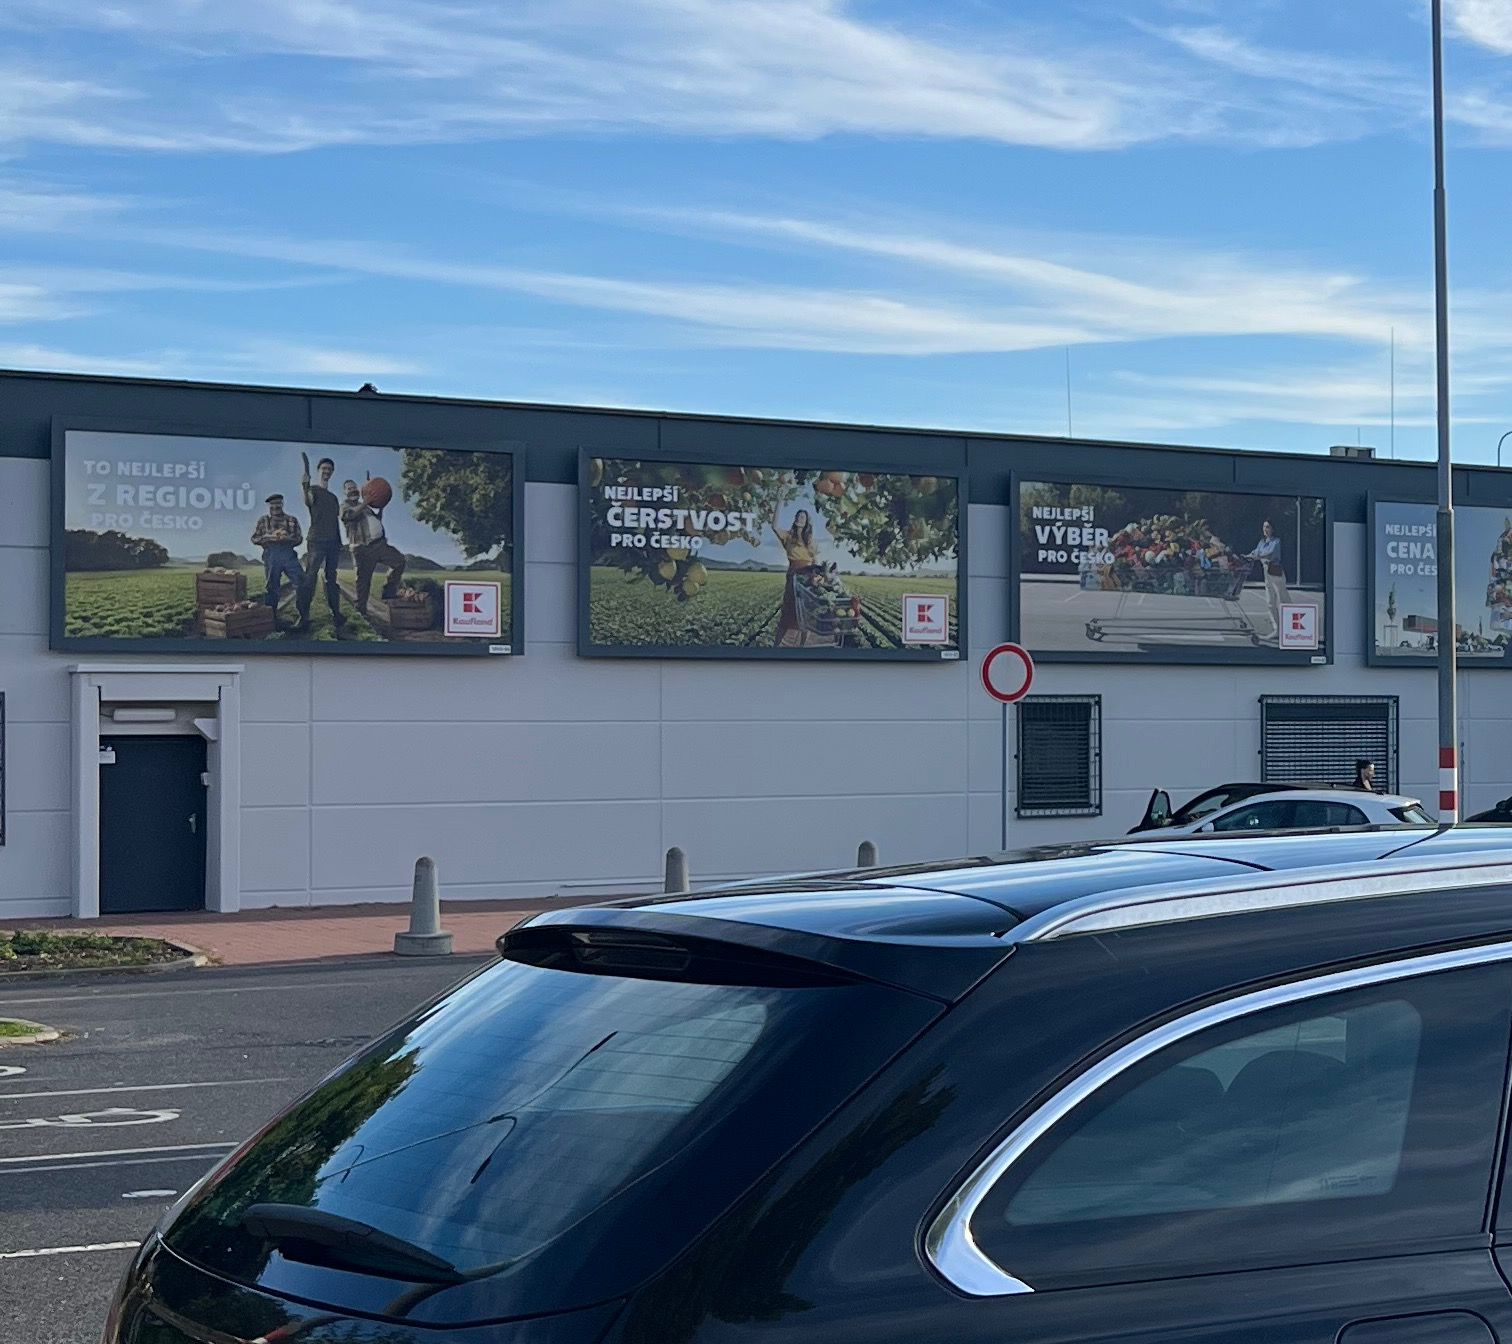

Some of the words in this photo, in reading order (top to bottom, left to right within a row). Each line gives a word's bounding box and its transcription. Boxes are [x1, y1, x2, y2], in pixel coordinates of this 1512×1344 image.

[84, 460, 111, 475] TO
[117, 461, 206, 479] NEJLEPŠÍ
[87, 483, 106, 506] Z
[116, 482, 256, 511] REGIONŮ
[604, 485, 679, 503] NEJLEPŠÍ
[92, 513, 133, 528] PRO
[139, 511, 204, 530] ČESKO
[606, 501, 757, 533] ČERSTVOST
[1032, 505, 1095, 522] NEJLEPŠÍ
[610, 533, 647, 548] PRO
[650, 531, 704, 550] ČESKO
[1034, 521, 1109, 547] VÝBĚR
[1038, 549, 1068, 564] PRO
[1070, 548, 1116, 564] ČESKO
[1386, 541, 1435, 560] CENA
[1390, 563, 1415, 575] PRO
[1417, 562, 1438, 576] ČES
[452, 617, 494, 626] Kaufland
